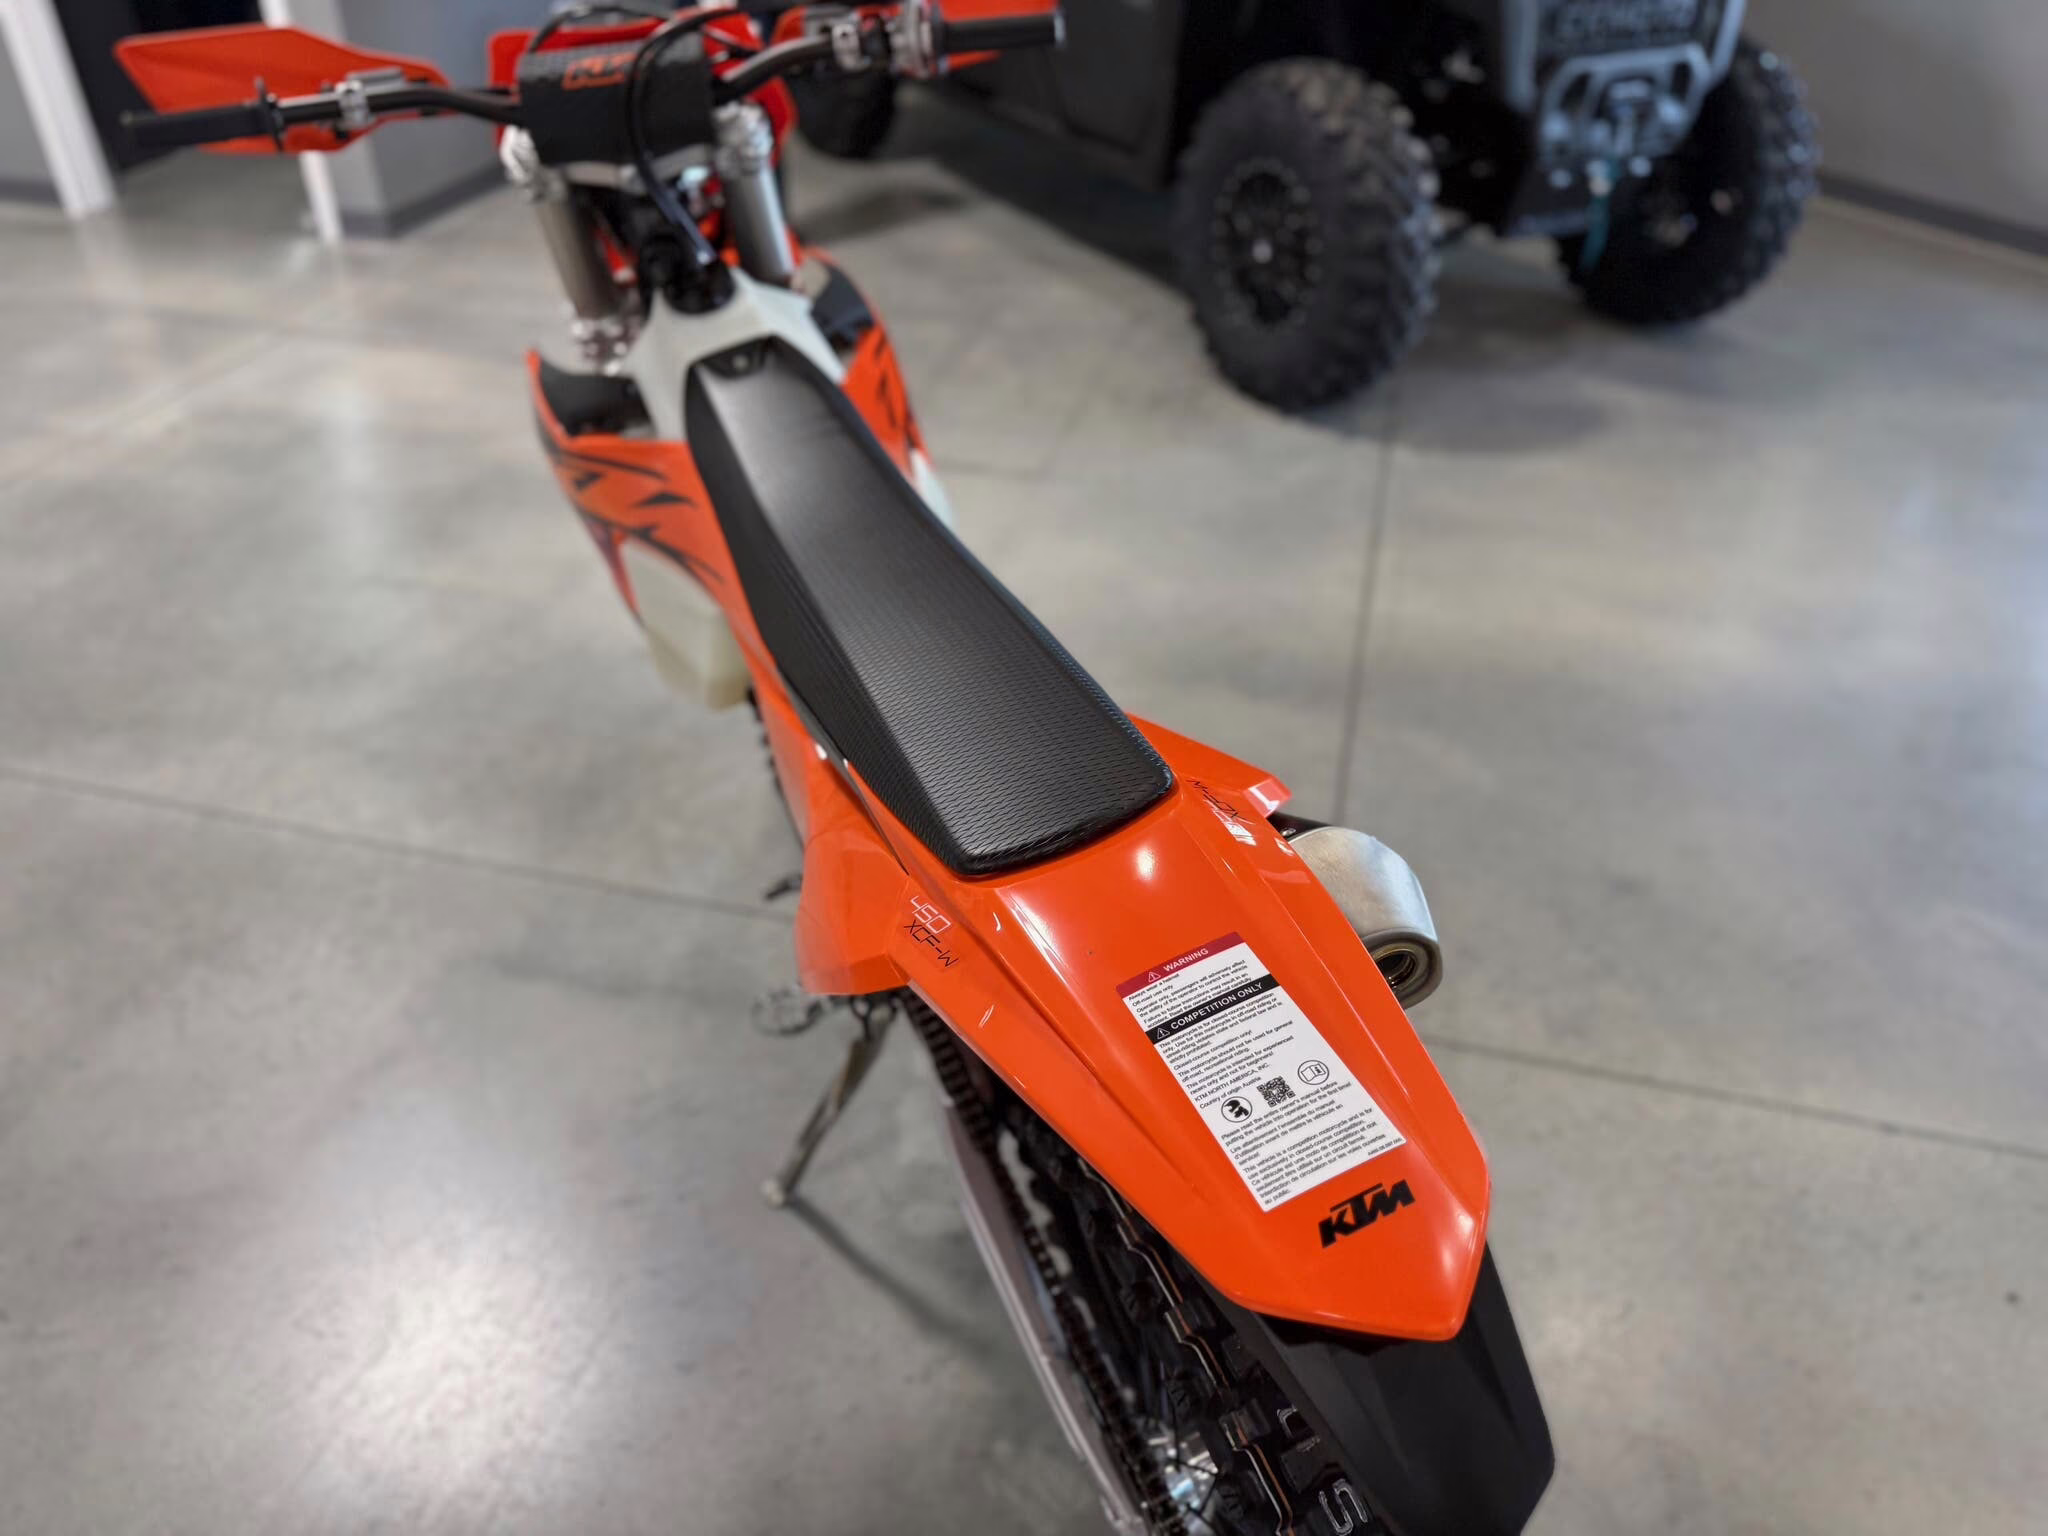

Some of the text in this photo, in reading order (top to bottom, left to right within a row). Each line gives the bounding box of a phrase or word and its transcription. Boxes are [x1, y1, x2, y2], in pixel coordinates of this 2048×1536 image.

[910, 895, 952, 934] 450
[904, 920, 959, 967] XCF-W
[1163, 948, 1208, 971] WARNING
[1170, 982, 1262, 1029] COMPETITION ONLY
[1318, 1179, 1416, 1249] KTM
